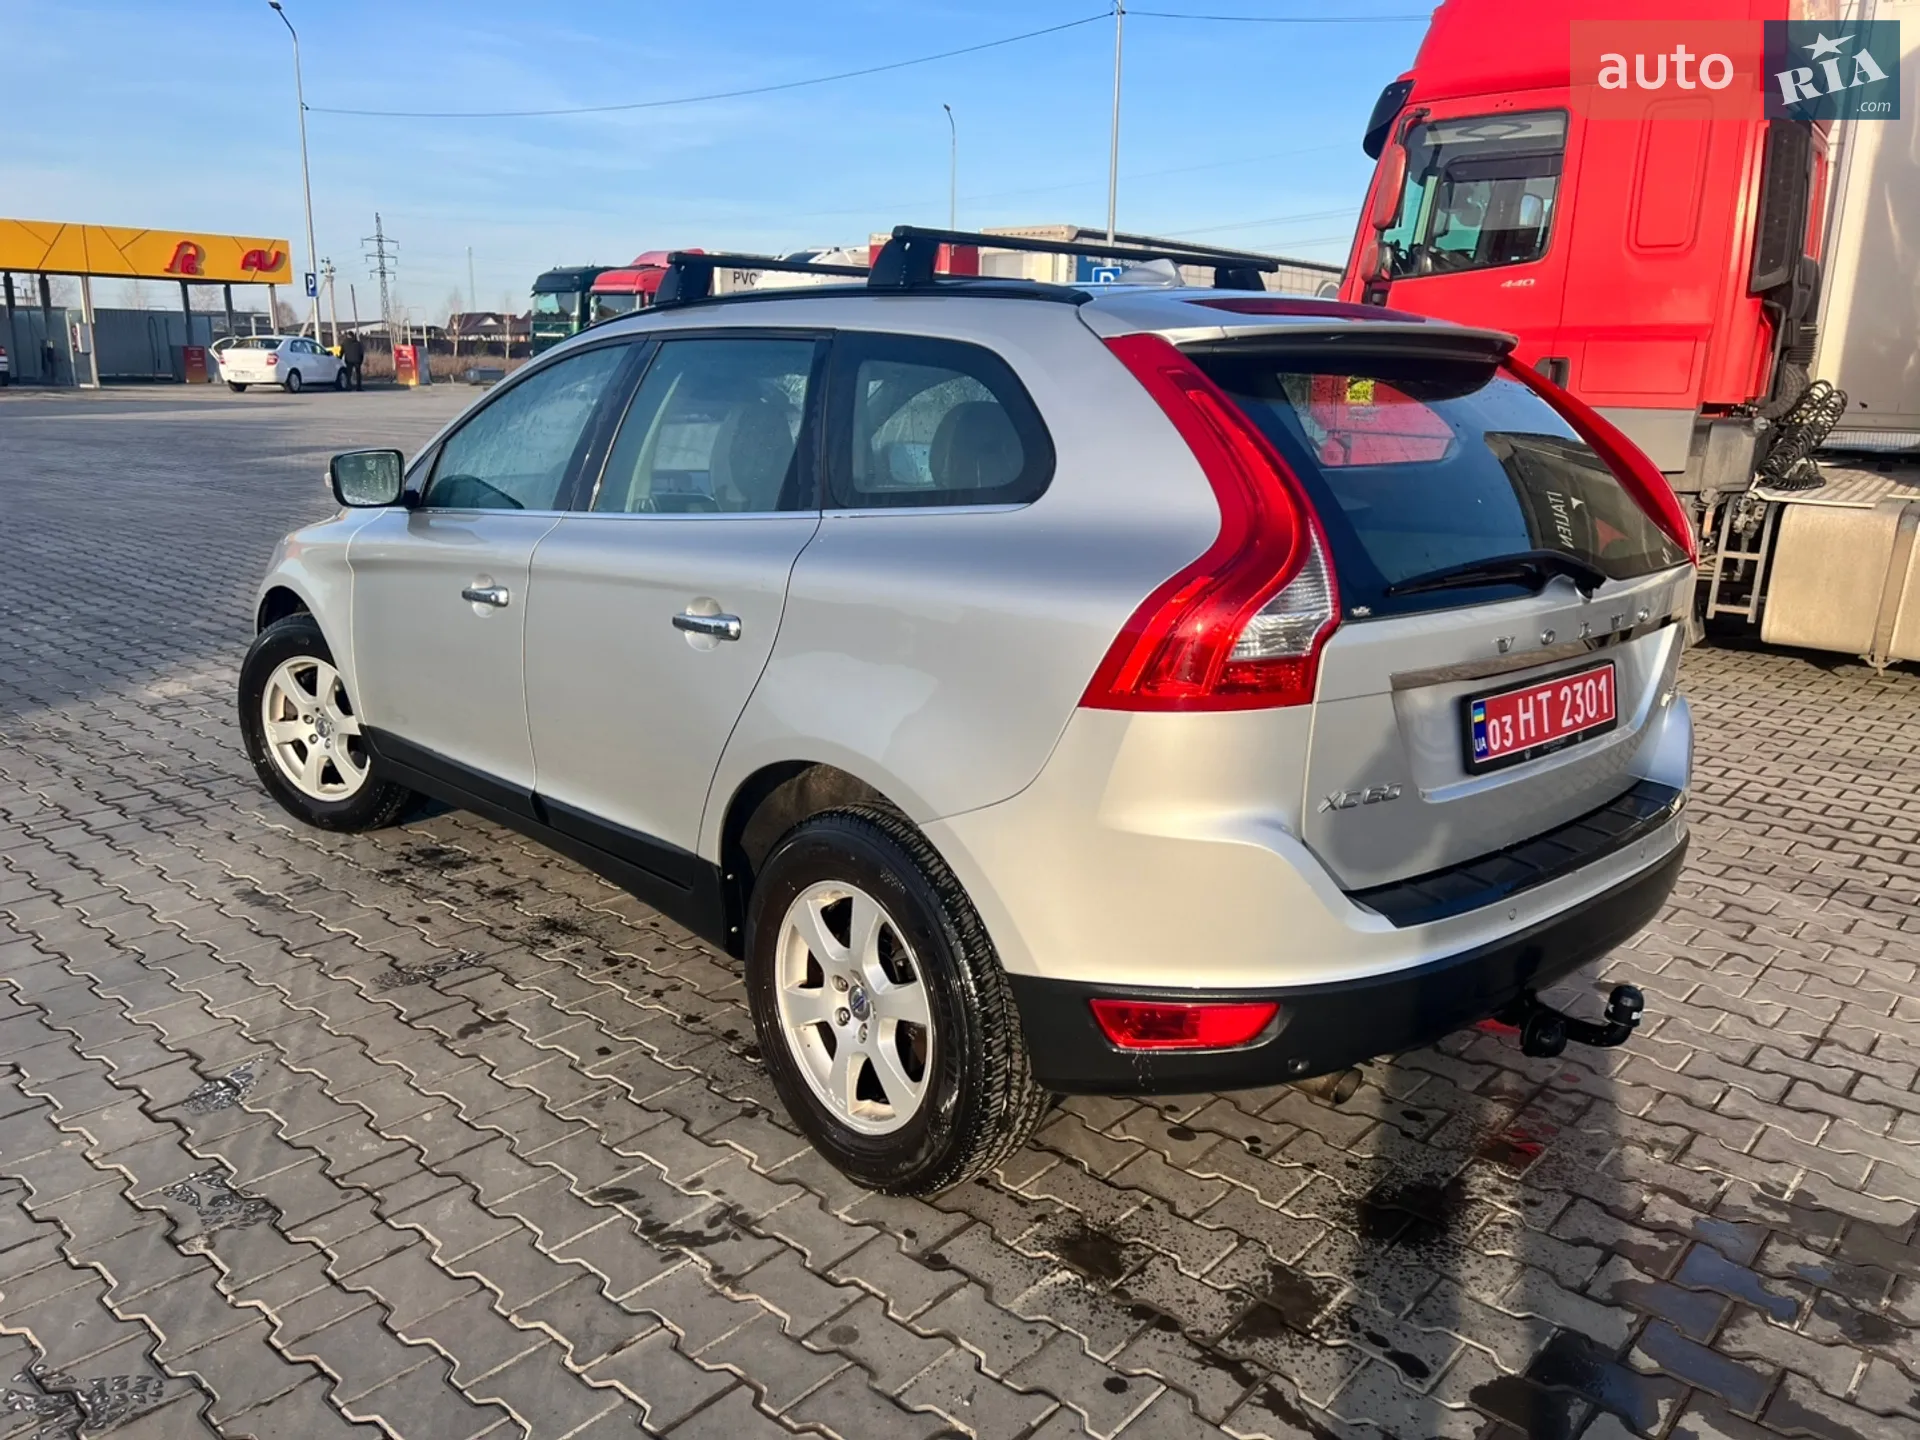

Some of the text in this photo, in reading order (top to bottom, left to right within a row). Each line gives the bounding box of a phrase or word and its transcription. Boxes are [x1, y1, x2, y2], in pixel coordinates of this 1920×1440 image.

[307, 274, 316, 295] P
[1500, 278, 1535, 288] 440
[1492, 606, 1650, 653] VOLVO
[1487, 674, 1609, 751] 03 HT 2301
[1474, 736, 1487, 752] UA
[1317, 781, 1403, 813] XC60
